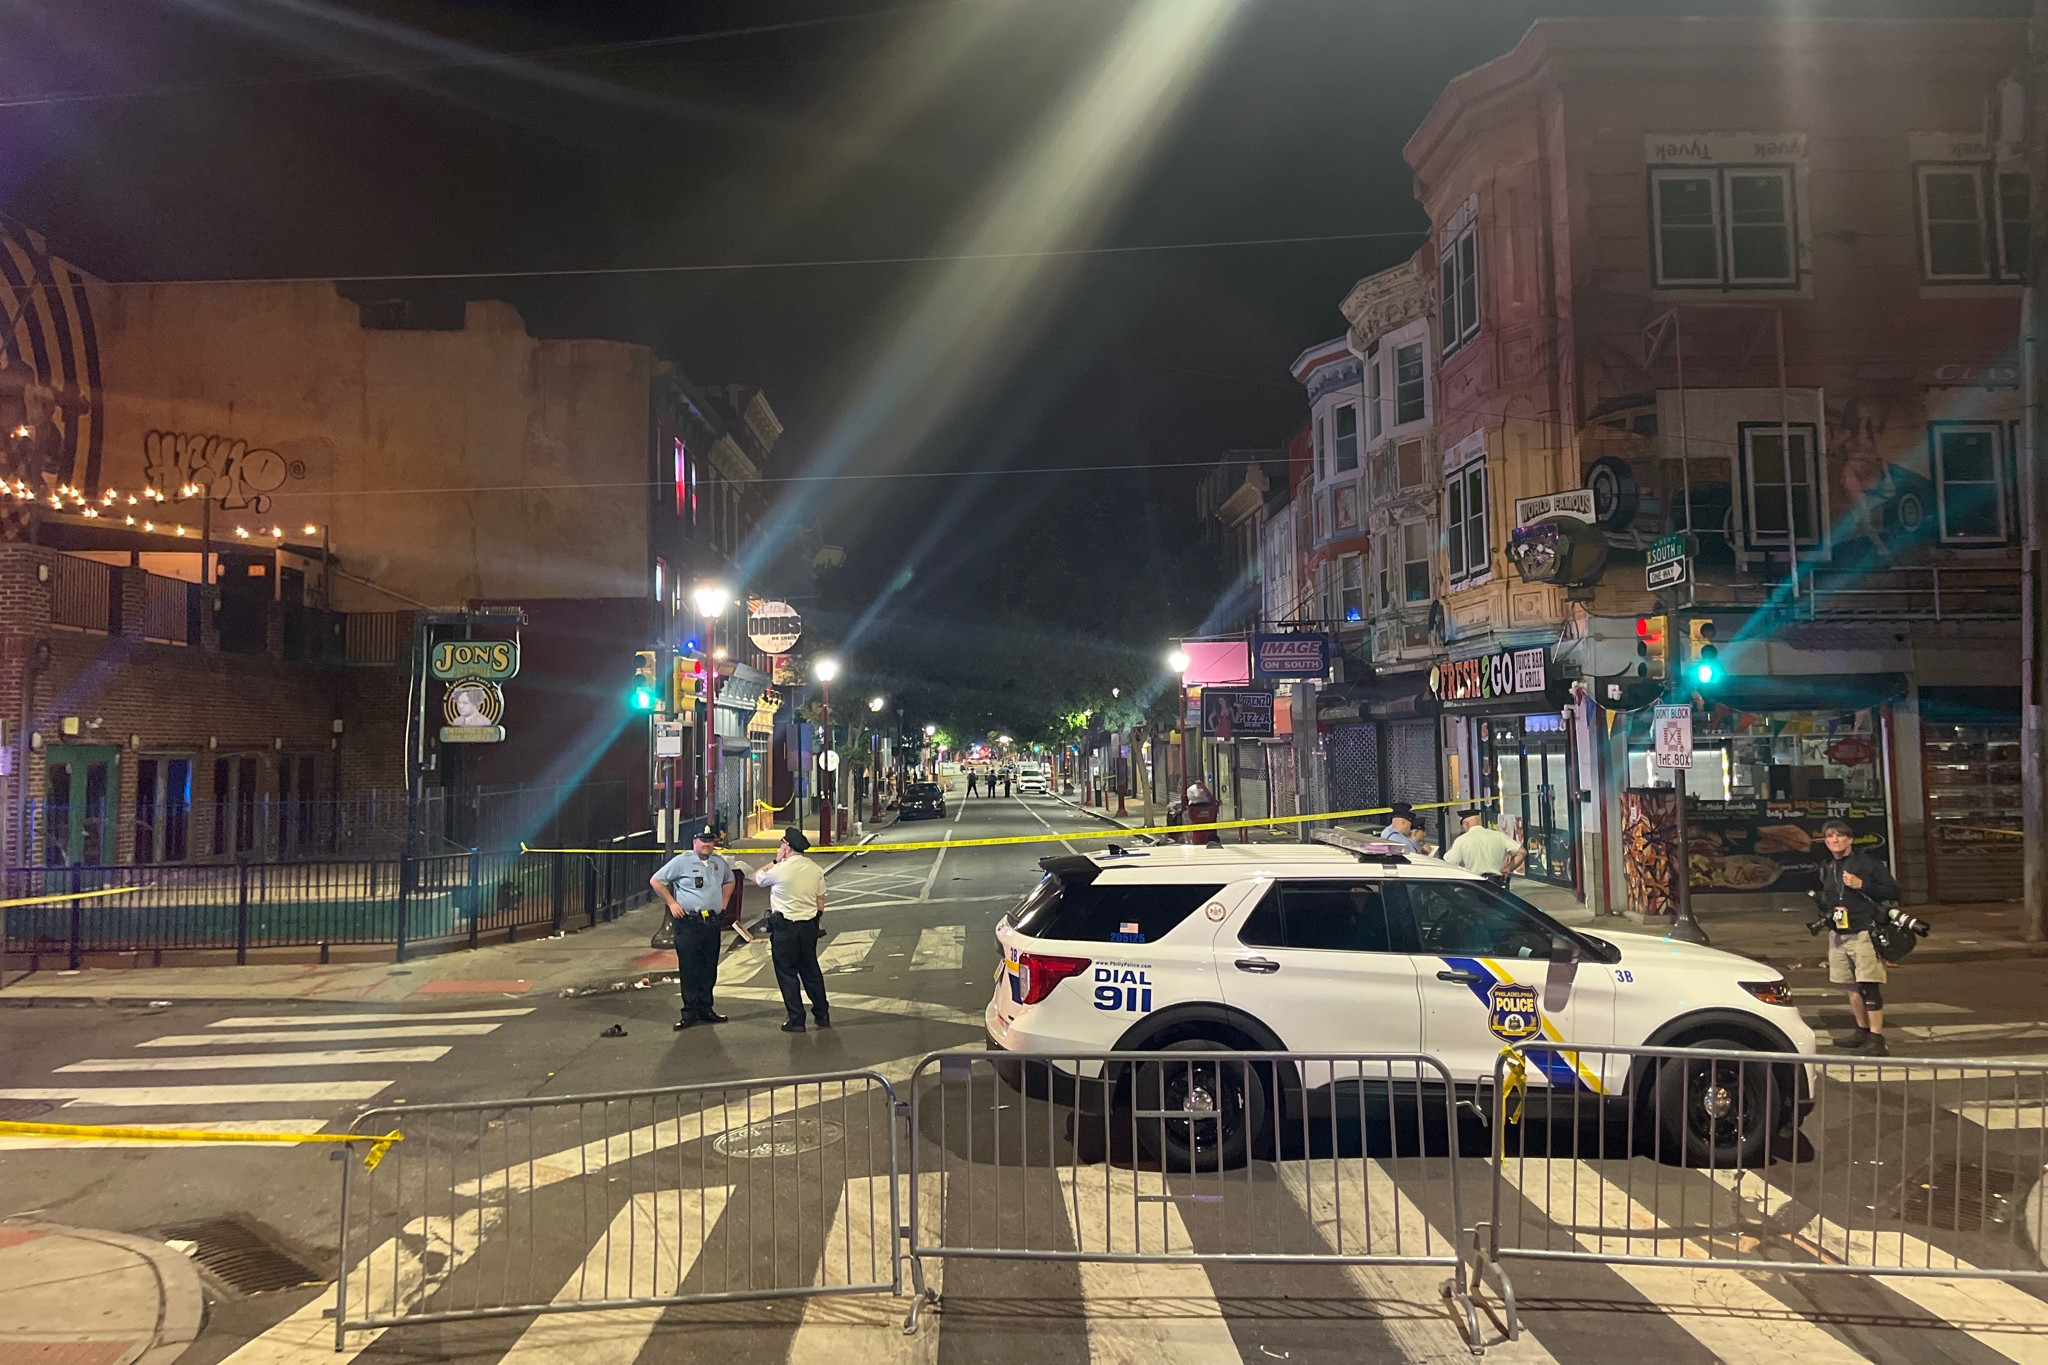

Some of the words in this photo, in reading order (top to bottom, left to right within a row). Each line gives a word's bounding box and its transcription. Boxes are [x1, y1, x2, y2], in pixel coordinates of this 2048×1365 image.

[1655, 139, 1712, 160] Tyvek
[1520, 499, 1551, 523] WORLD
[1554, 494, 1592, 515] FAMOUS
[1652, 543, 1676, 563] SOUTH
[1651, 571, 1662, 582] ONE
[1663, 568, 1675, 579] WAY
[749, 616, 801, 636] DOBBS
[1261, 642, 1322, 655] IMAGE
[434, 644, 510, 672] JONS
[1264, 661, 1280, 669] ON
[1284, 660, 1319, 669] SOUTH
[1515, 654, 1531, 674] JUICE
[1531, 651, 1543, 669] BAR
[1524, 670, 1542, 688] GRILL
[1236, 693, 1272, 708] LORENZO
[1239, 712, 1271, 724] PIZZA
[1670, 708, 1690, 719] BLOCK
[1658, 753, 1672, 765] THE
[1674, 753, 1691, 766] BOX
[1010, 947, 1018, 963] 3B
[1094, 968, 1152, 985] DIAL
[1614, 970, 1634, 983] 3B
[1094, 985, 1152, 1013] 911
[1496, 997, 1535, 1013] POLICE
